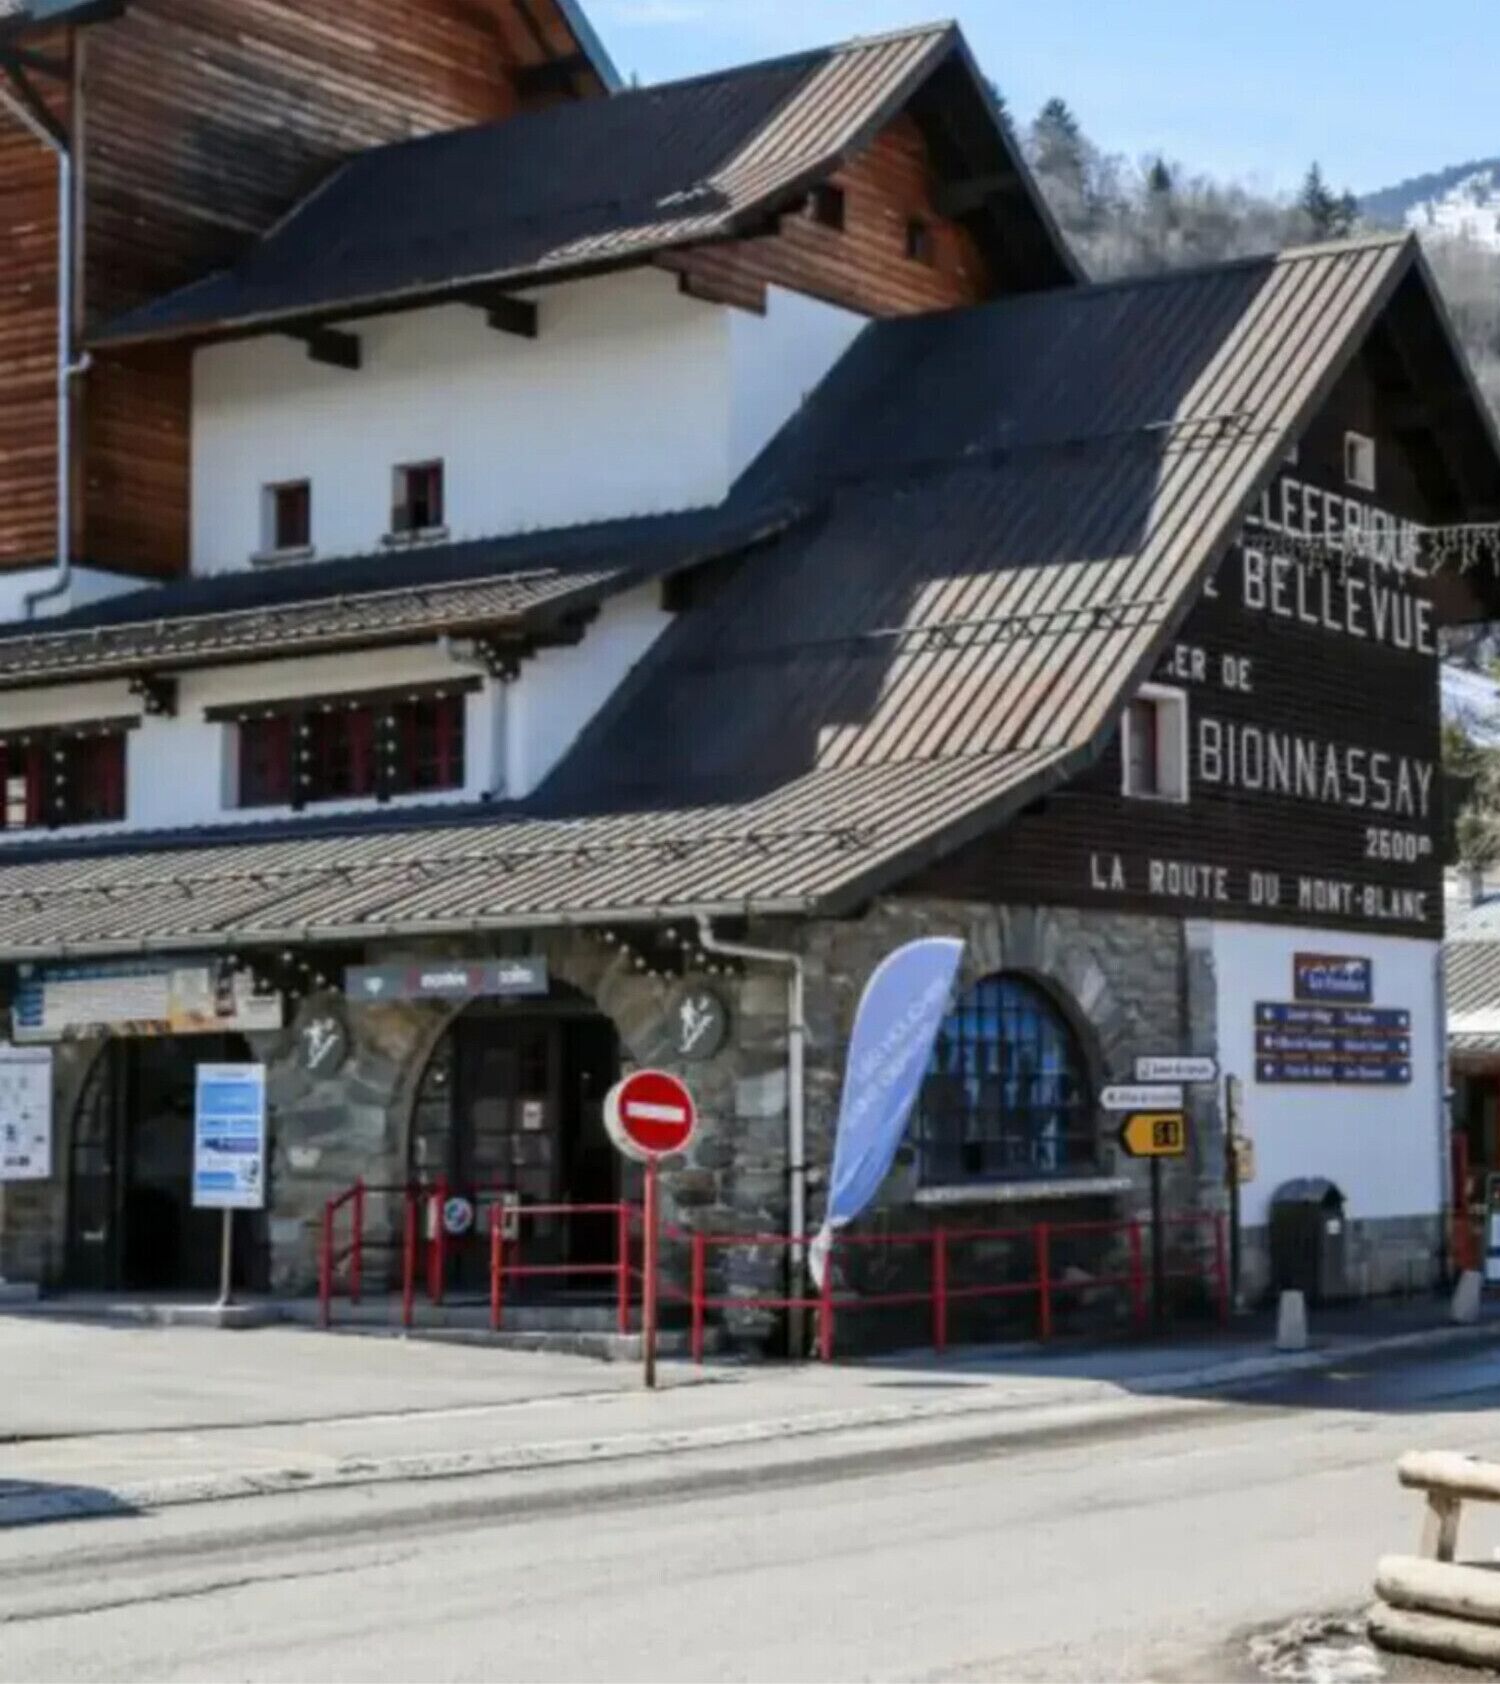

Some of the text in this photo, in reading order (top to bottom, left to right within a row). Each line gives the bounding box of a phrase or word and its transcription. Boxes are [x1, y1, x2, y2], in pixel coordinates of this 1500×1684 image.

[1246, 477, 1429, 578] LEFERIQUE
[1244, 547, 1435, 656] BELLEVUE
[1222, 654, 1253, 693] DE
[1199, 718, 1434, 818] BIONNASSAY
[1090, 853, 1427, 923] LA ROUTE DU MONT-BLANC
